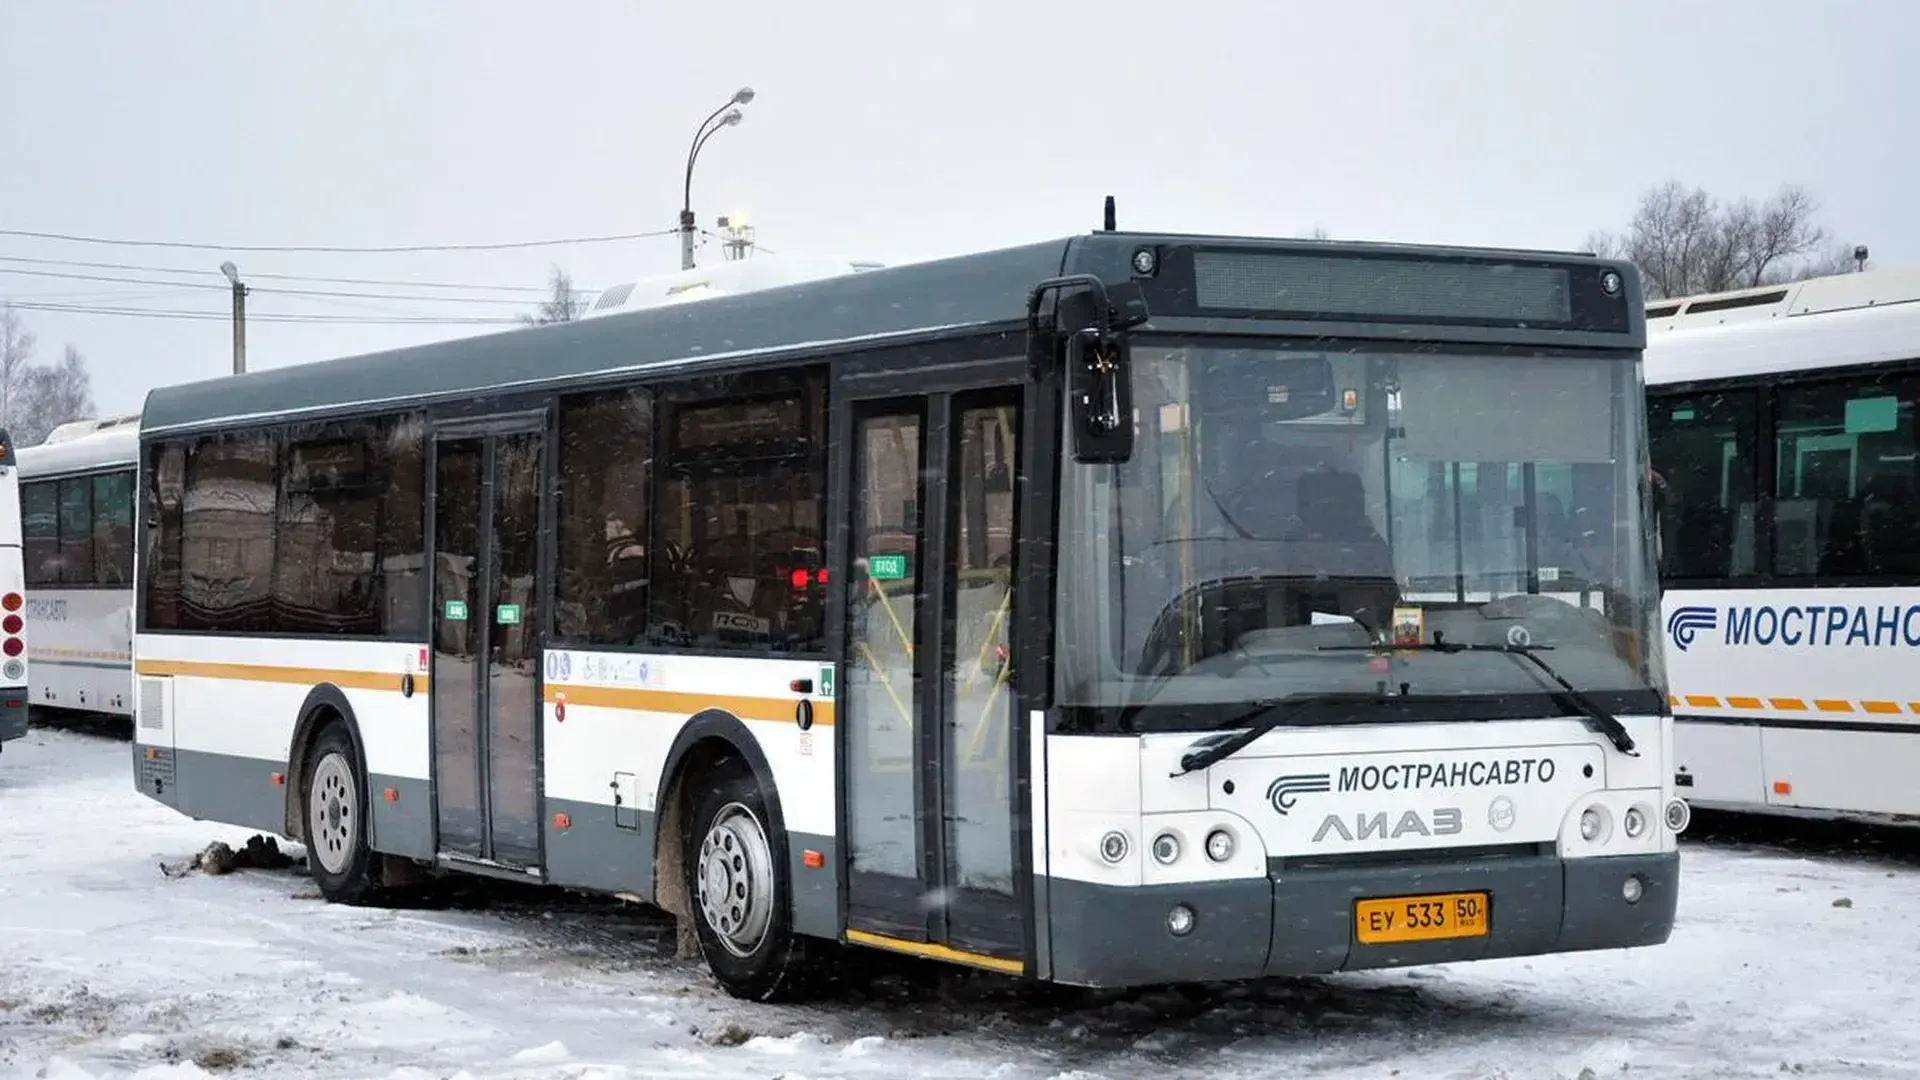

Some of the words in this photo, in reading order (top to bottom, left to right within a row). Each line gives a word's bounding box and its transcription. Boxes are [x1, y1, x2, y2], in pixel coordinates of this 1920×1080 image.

[1724, 605, 1920, 647] МОСТРАНС
[1338, 758, 1555, 792] МОСТРАНСАВТО
[1312, 808, 1463, 842] ЛИАЗ
[1406, 902, 1446, 928] 533
[1457, 898, 1477, 918] 50
